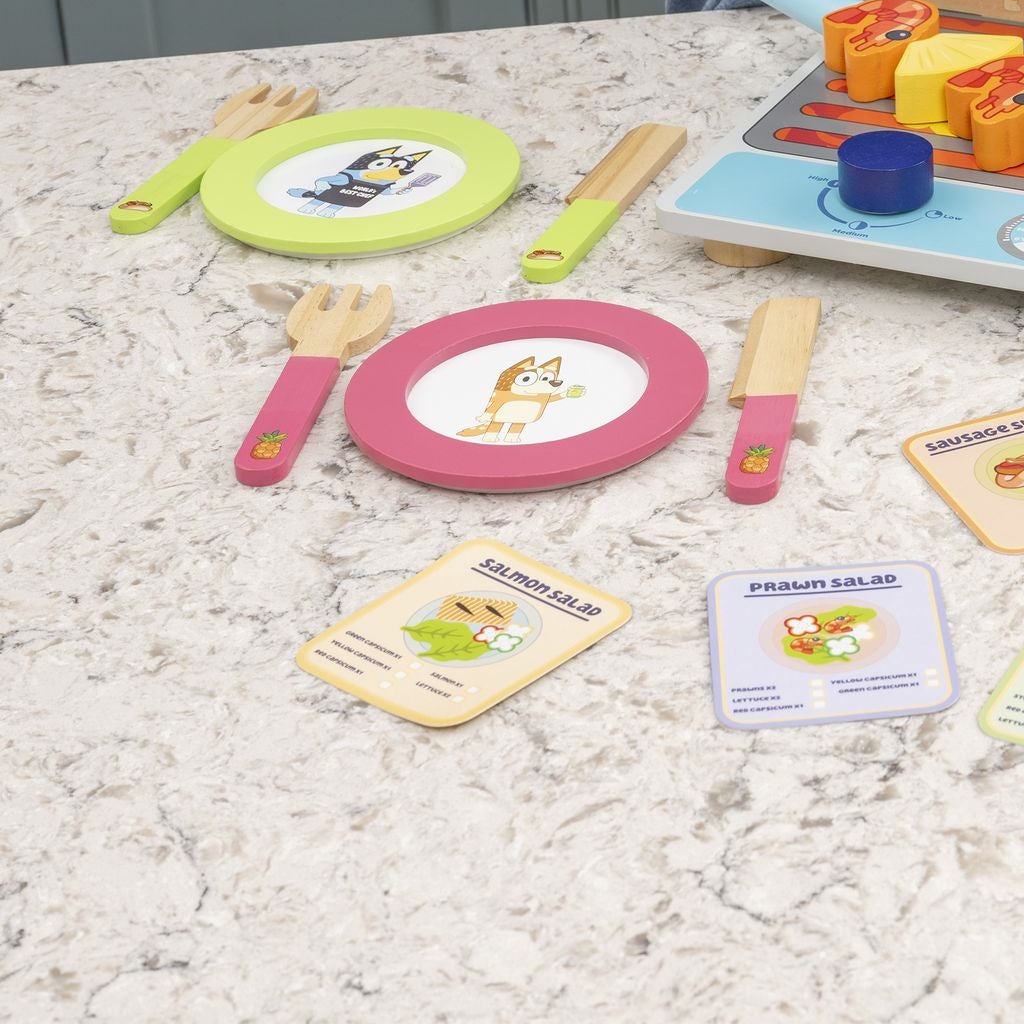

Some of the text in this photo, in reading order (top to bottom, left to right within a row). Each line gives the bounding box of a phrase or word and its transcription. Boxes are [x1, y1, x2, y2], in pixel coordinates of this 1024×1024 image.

[832, 228, 868, 238] Medium
[925, 424, 1010, 452] SAUSAGE
[479, 558, 602, 617] SALMON SALAD
[750, 574, 897, 592] PRAWN SALAD
